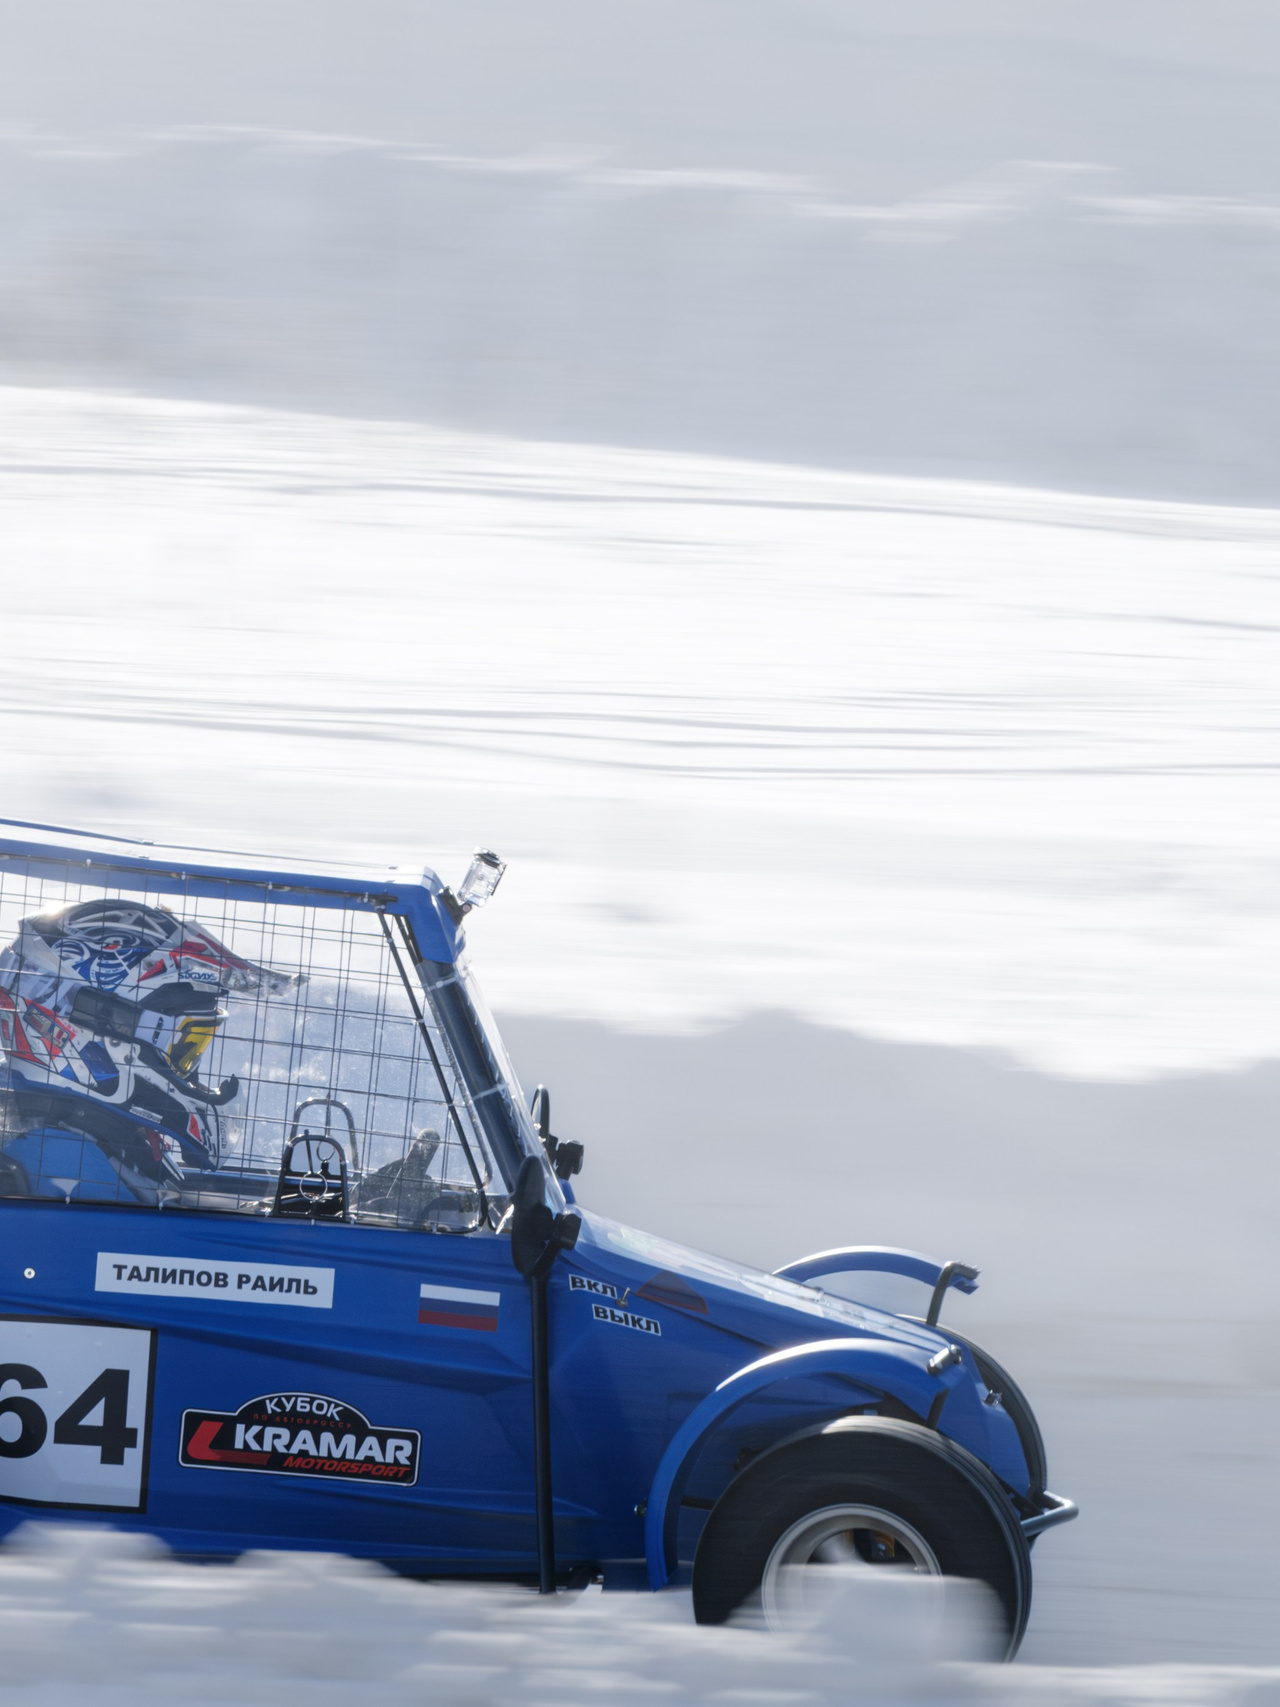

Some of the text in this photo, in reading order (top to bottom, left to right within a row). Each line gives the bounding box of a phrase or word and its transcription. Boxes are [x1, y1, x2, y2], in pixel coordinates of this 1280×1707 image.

[112, 1263, 318, 1296] ТАЛИПОВ РАИЛЬ
[571, 1275, 616, 1298] ВКЛ
[593, 1304, 660, 1335] ВЫКЛ
[265, 1396, 345, 1421] КУБОК
[234, 1423, 413, 1466] KRAMAR
[282, 1455, 411, 1479] MOTORSPORT
